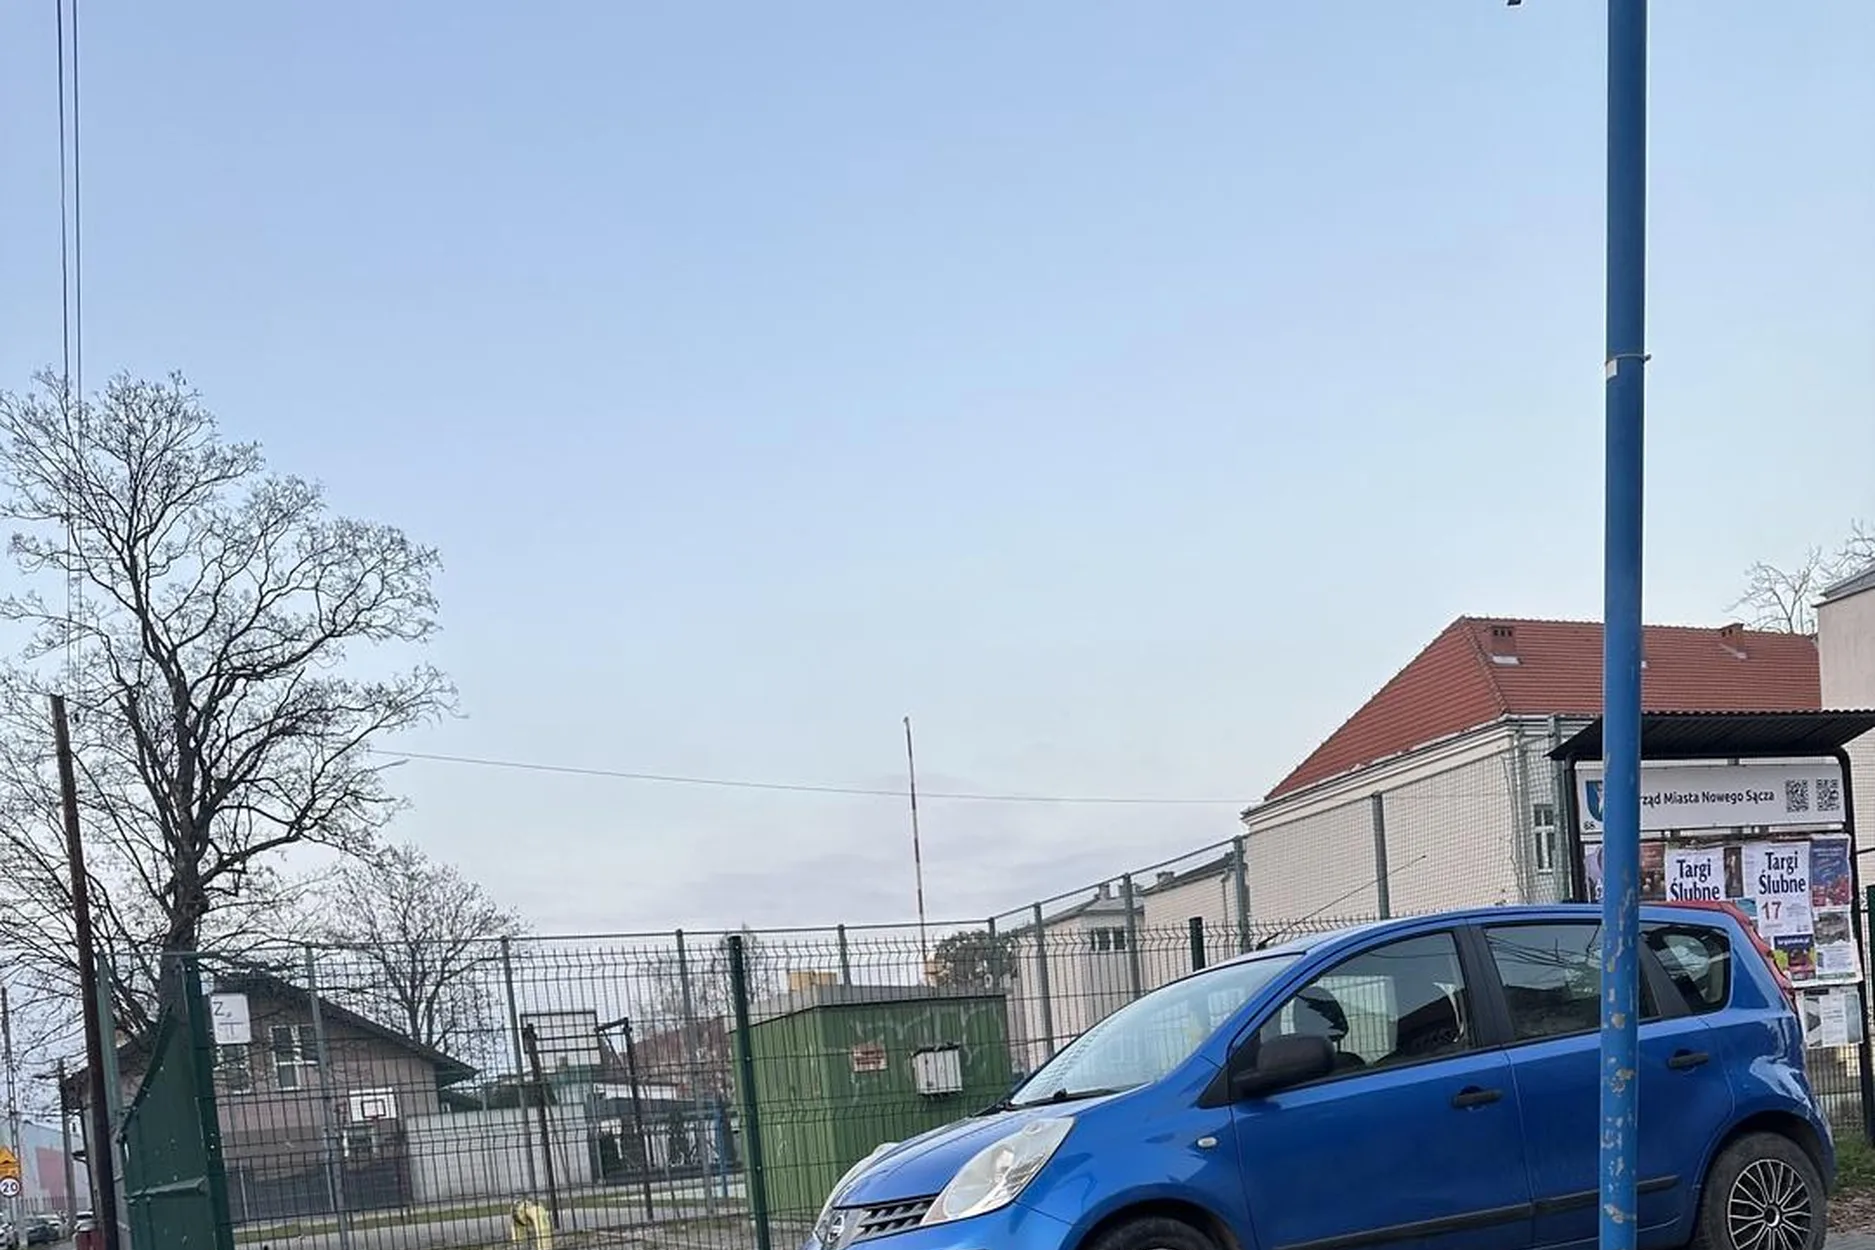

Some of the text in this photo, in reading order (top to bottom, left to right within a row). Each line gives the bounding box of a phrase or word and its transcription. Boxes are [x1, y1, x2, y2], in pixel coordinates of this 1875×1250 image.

[1663, 791, 1700, 805] Miasta
[1701, 791, 1744, 804] Nowego
[1745, 790, 1775, 804] Sącza
[1676, 858, 1711, 883] Targi
[1764, 850, 1799, 876] Targi
[1670, 877, 1720, 901] Ślubne
[1758, 869, 1806, 895] Ślubne
[1761, 901, 1781, 920] 17
[1, 1182, 18, 1193] 20
